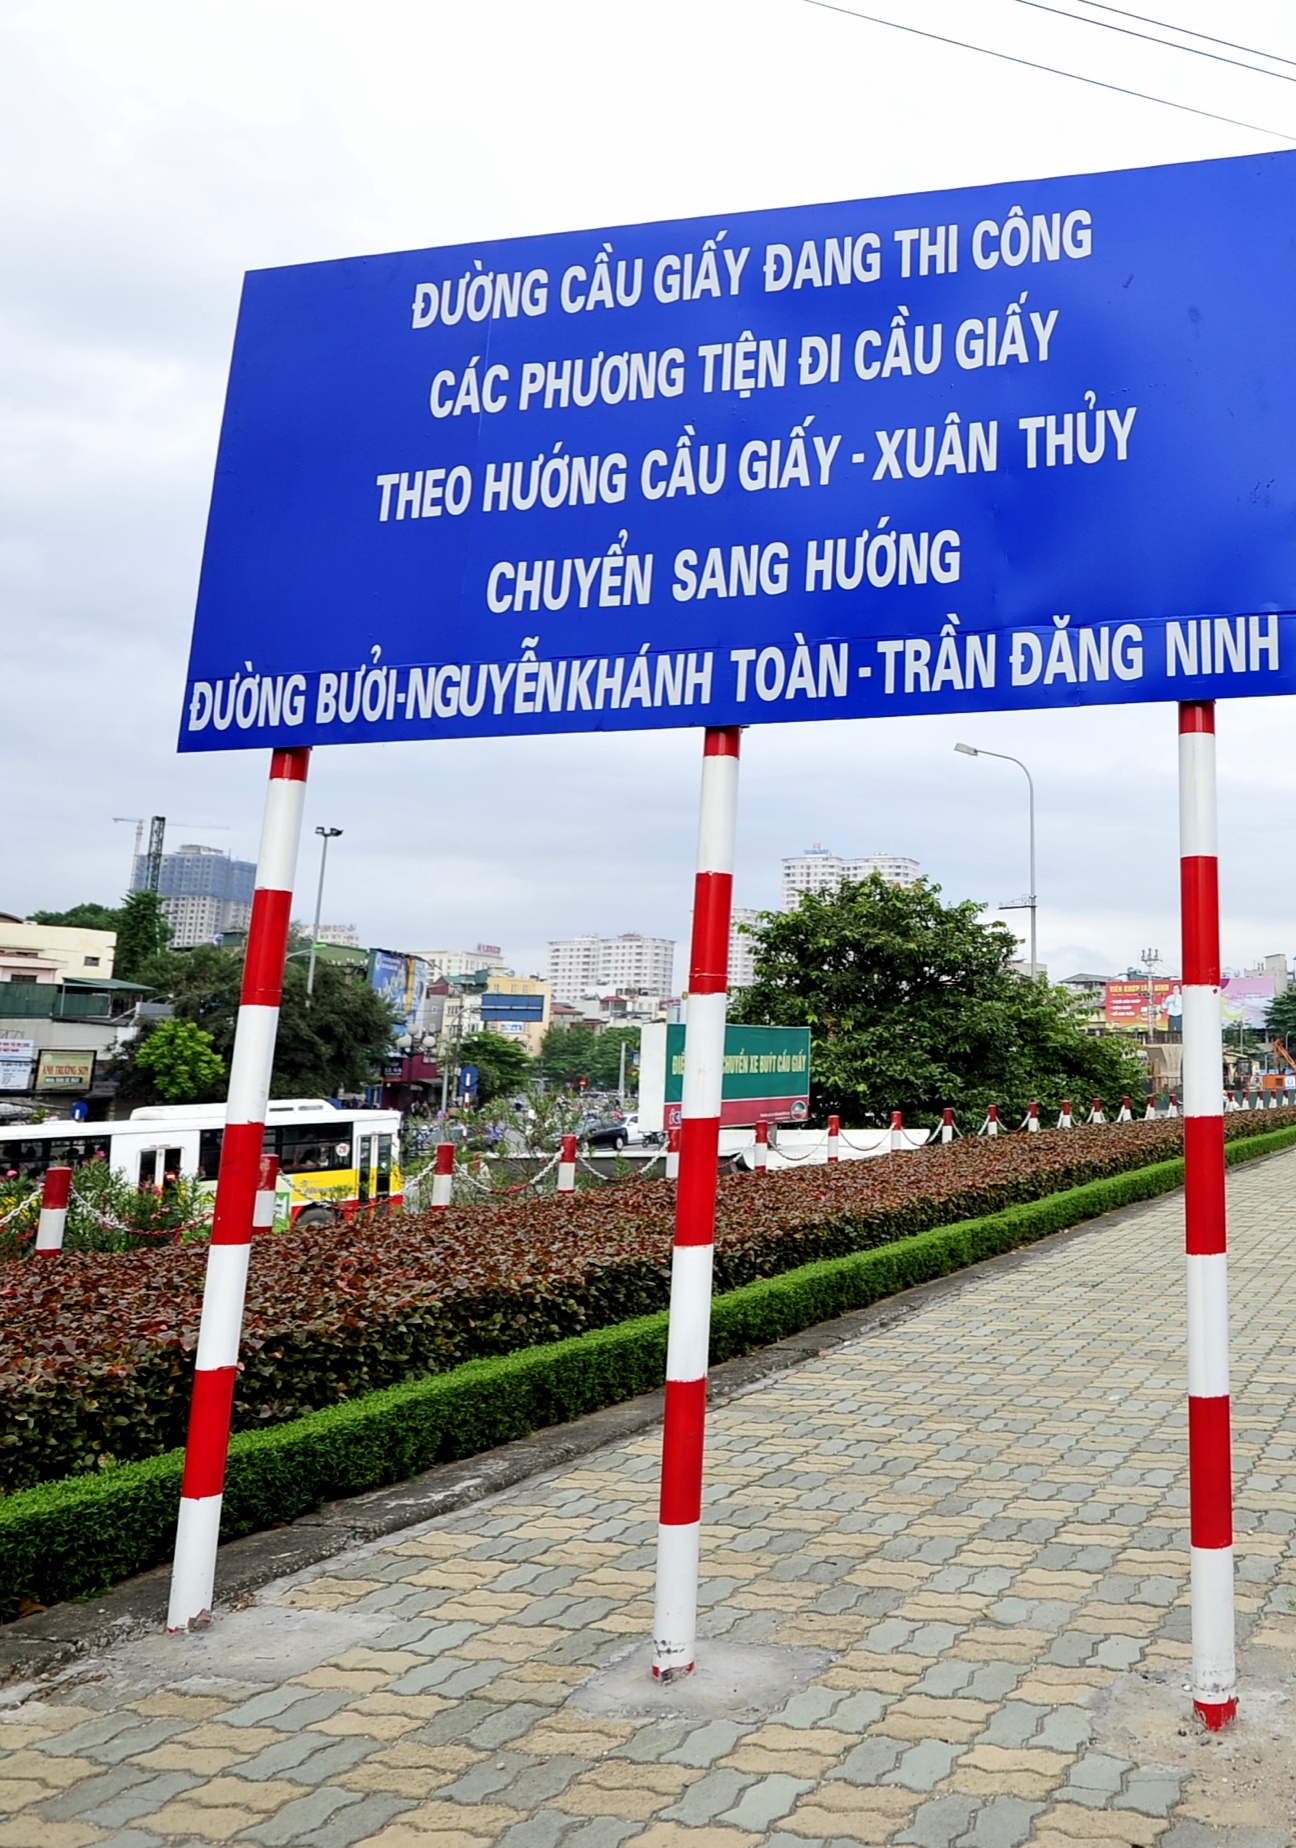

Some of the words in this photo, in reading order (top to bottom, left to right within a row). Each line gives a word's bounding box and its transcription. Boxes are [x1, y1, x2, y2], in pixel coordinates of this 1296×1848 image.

[411, 259, 549, 329] ĐƯỜNG
[560, 242, 643, 314] CẦU
[653, 229, 751, 304] GIẤY
[762, 232, 881, 292] ĐANG
[893, 224, 958, 278] THI
[972, 205, 1092, 270] CÔNG
[430, 355, 510, 418] CÁC
[519, 347, 685, 411] PHƯƠNG
[698, 330, 787, 399] TIỆN
[798, 333, 841, 386] ĐI
[854, 305, 943, 381] CẦU
[955, 290, 1059, 370] GIẤY
[376, 465, 472, 522] THEO
[482, 441, 627, 512] HƯỚNG
[641, 424, 727, 500] CẦU
[738, 415, 842, 492] GIẤY
[872, 411, 998, 481] XUÂN
[1018, 390, 1137, 469] THỦY
[486, 528, 654, 614] CHUYỂN
[672, 541, 789, 602] SANG
[805, 515, 961, 592] HƯỚNG
[188, 660, 306, 731] ĐƯỜNG
[730, 632, 849, 702] TOÀN
[877, 613, 996, 694] TRẦN
[1009, 614, 1143, 686] ĐĂNG
[1165, 614, 1279, 677] NINH
[749, 1055, 759, 1074] XE
[759, 1051, 777, 1074] BUÝT
[777, 1048, 791, 1073] CẦU
[791, 1048, 807, 1072] GIẤY
